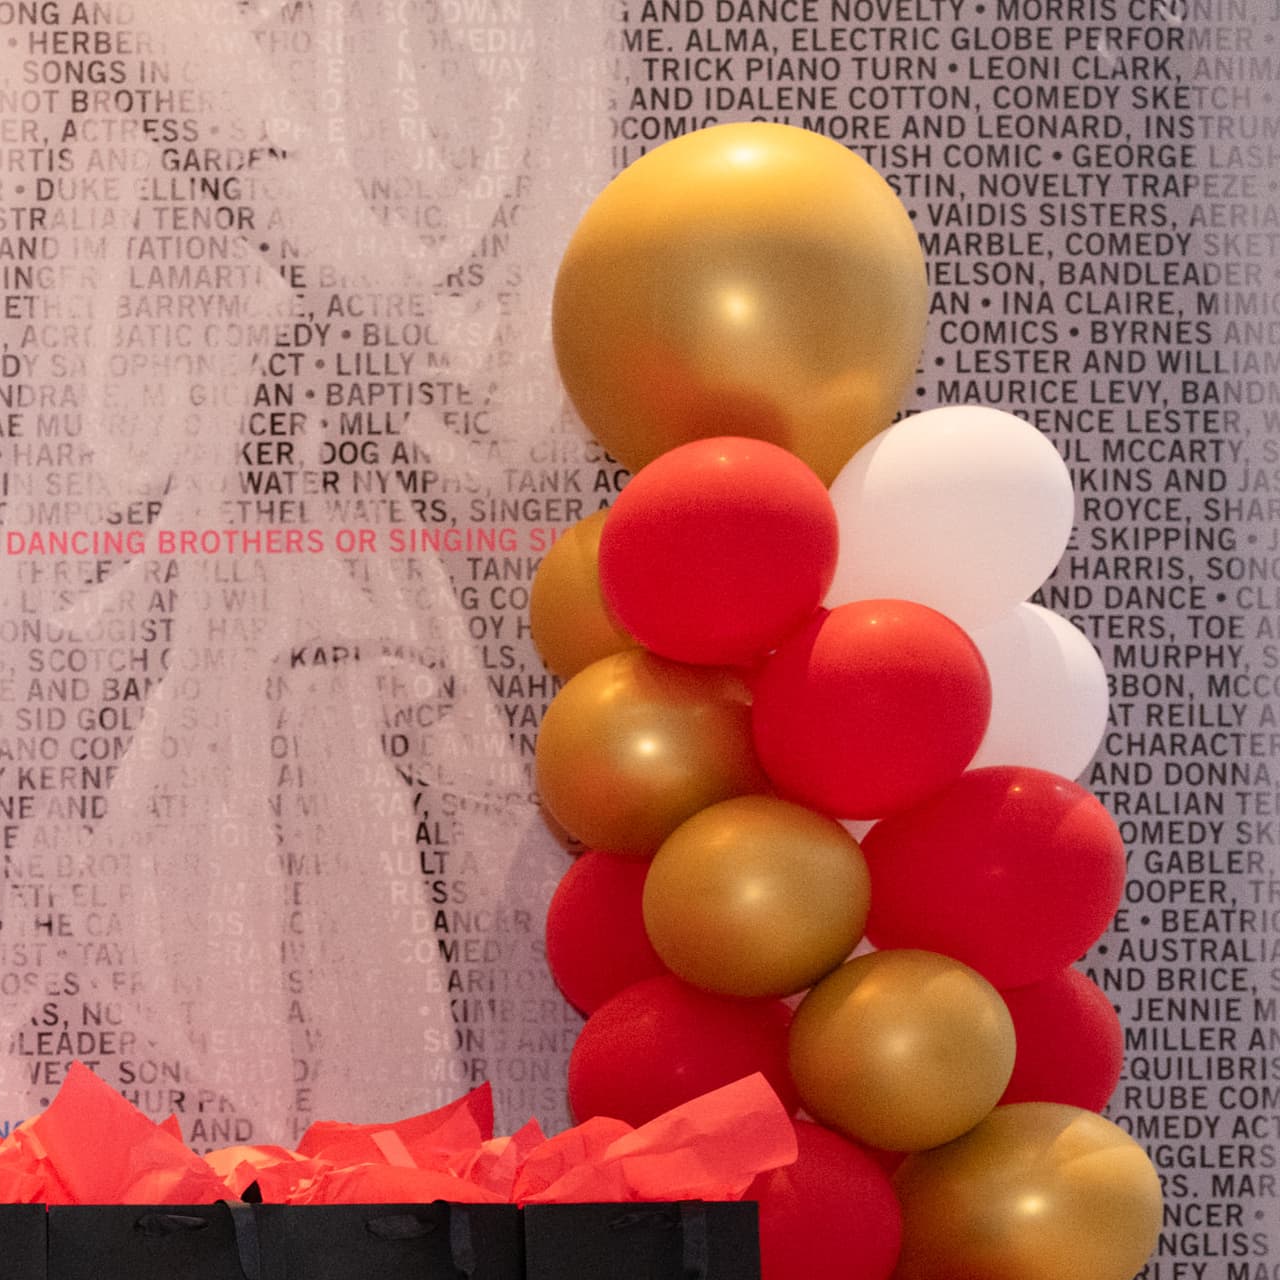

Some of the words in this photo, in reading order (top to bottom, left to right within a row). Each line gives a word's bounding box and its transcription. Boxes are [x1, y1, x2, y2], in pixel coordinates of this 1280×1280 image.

[640, 0, 704, 23] AND
[716, 0, 819, 23] DANCE
[831, 0, 962, 22] NOVELTY
[996, 0, 1117, 21] MORRIS
[684, 27, 779, 53] ALMA,
[791, 26, 940, 52] ELECTRIC
[950, 26, 1053, 51] GLOBE
[642, 57, 734, 82] TRICK
[745, 56, 841, 82] PIANO
[851, 56, 937, 81] TURN
[1072, 55, 1182, 82] CLARK,
[630, 86, 694, 111] AND
[705, 86, 838, 111] IDALENE
[848, 85, 981, 112] COTTON,
[992, 85, 1120, 110] COMEDY
[901, 114, 966, 139] AND
[977, 114, 1132, 142] LEONARD,
[943, 143, 1043, 169] COMIC
[1072, 143, 1194, 169] GEORGE
[978, 173, 1112, 198] NOVELTY
[1039, 202, 1178, 229] SISTERS,
[1065, 232, 1192, 257] COMEDY
[1058, 261, 1261, 287] BANDLEADER
[1002, 290, 1055, 315] INA
[1064, 290, 1184, 317] CLAIRE,
[939, 320, 1059, 345] COMICS
[1090, 320, 1212, 345] BYRNES
[956, 349, 1071, 374] LESTER
[937, 379, 1079, 404] MAURICE
[1090, 379, 1169, 405] LEVY,
[1083, 497, 1192, 523] ROYCE,
[7, 530, 146, 555] DANCING
[158, 528, 325, 554] BROTHERS
[335, 528, 377, 554] OR
[389, 527, 518, 554] SINGING
[1090, 526, 1236, 551] SKIPPING
[1070, 556, 1194, 581] HARRIS,
[1104, 585, 1207, 610] DANCE
[1113, 644, 1249, 669] MURPHY,
[1146, 702, 1247, 728] REILLY
[1088, 761, 1153, 786] AND
[1144, 849, 1275, 875] GABLER,
[1156, 967, 1257, 993] BRICE,
[1131, 997, 1242, 1022] JENNIE
[1124, 1085, 1192, 1110] RUBE
